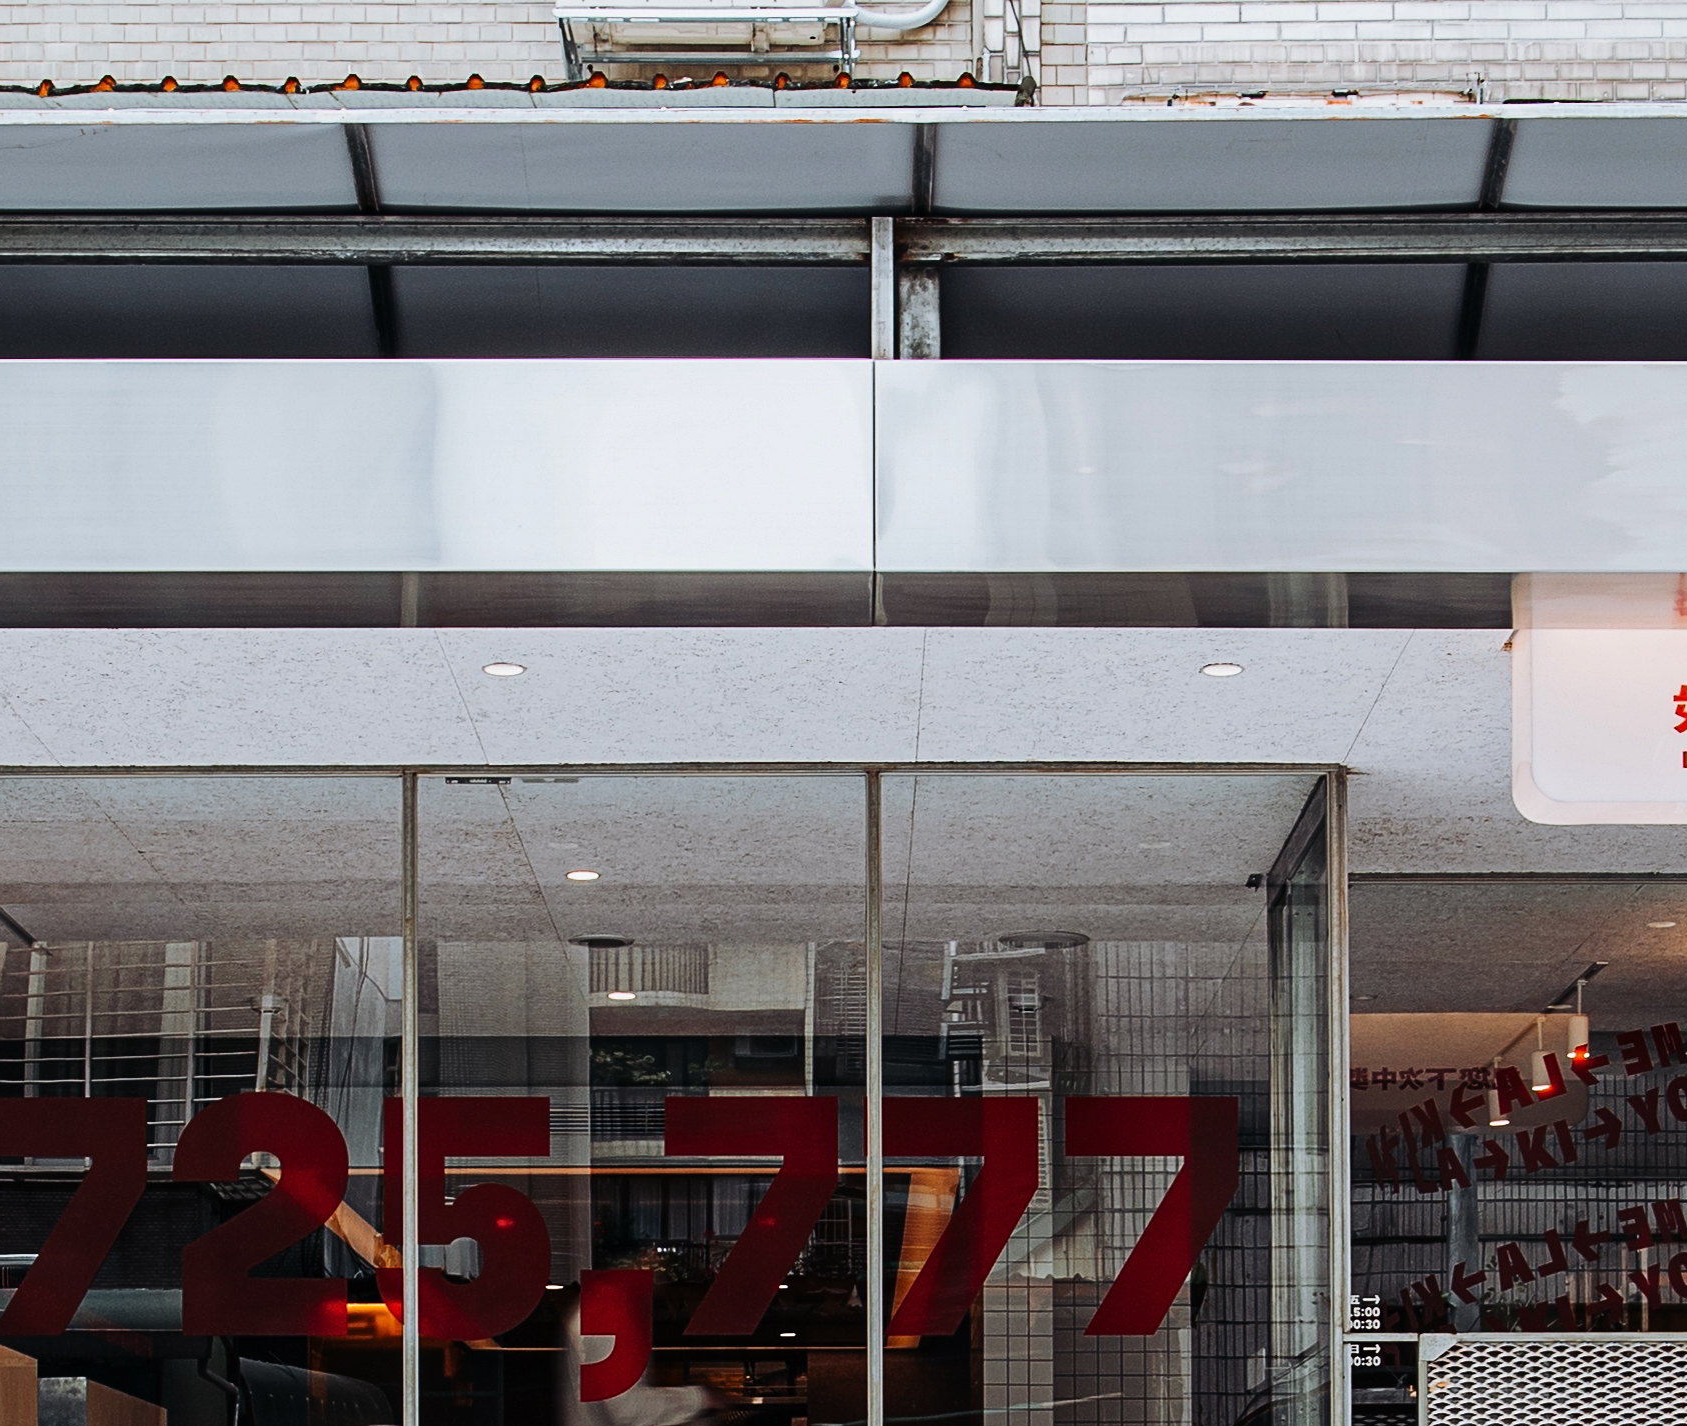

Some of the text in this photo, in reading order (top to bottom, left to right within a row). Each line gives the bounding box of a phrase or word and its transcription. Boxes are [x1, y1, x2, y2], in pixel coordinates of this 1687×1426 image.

[1515, 1119, 1577, 1173] KI
[1350, 1307, 1381, 1317] 5:00
[1350, 1356, 1381, 1367] 0:30
